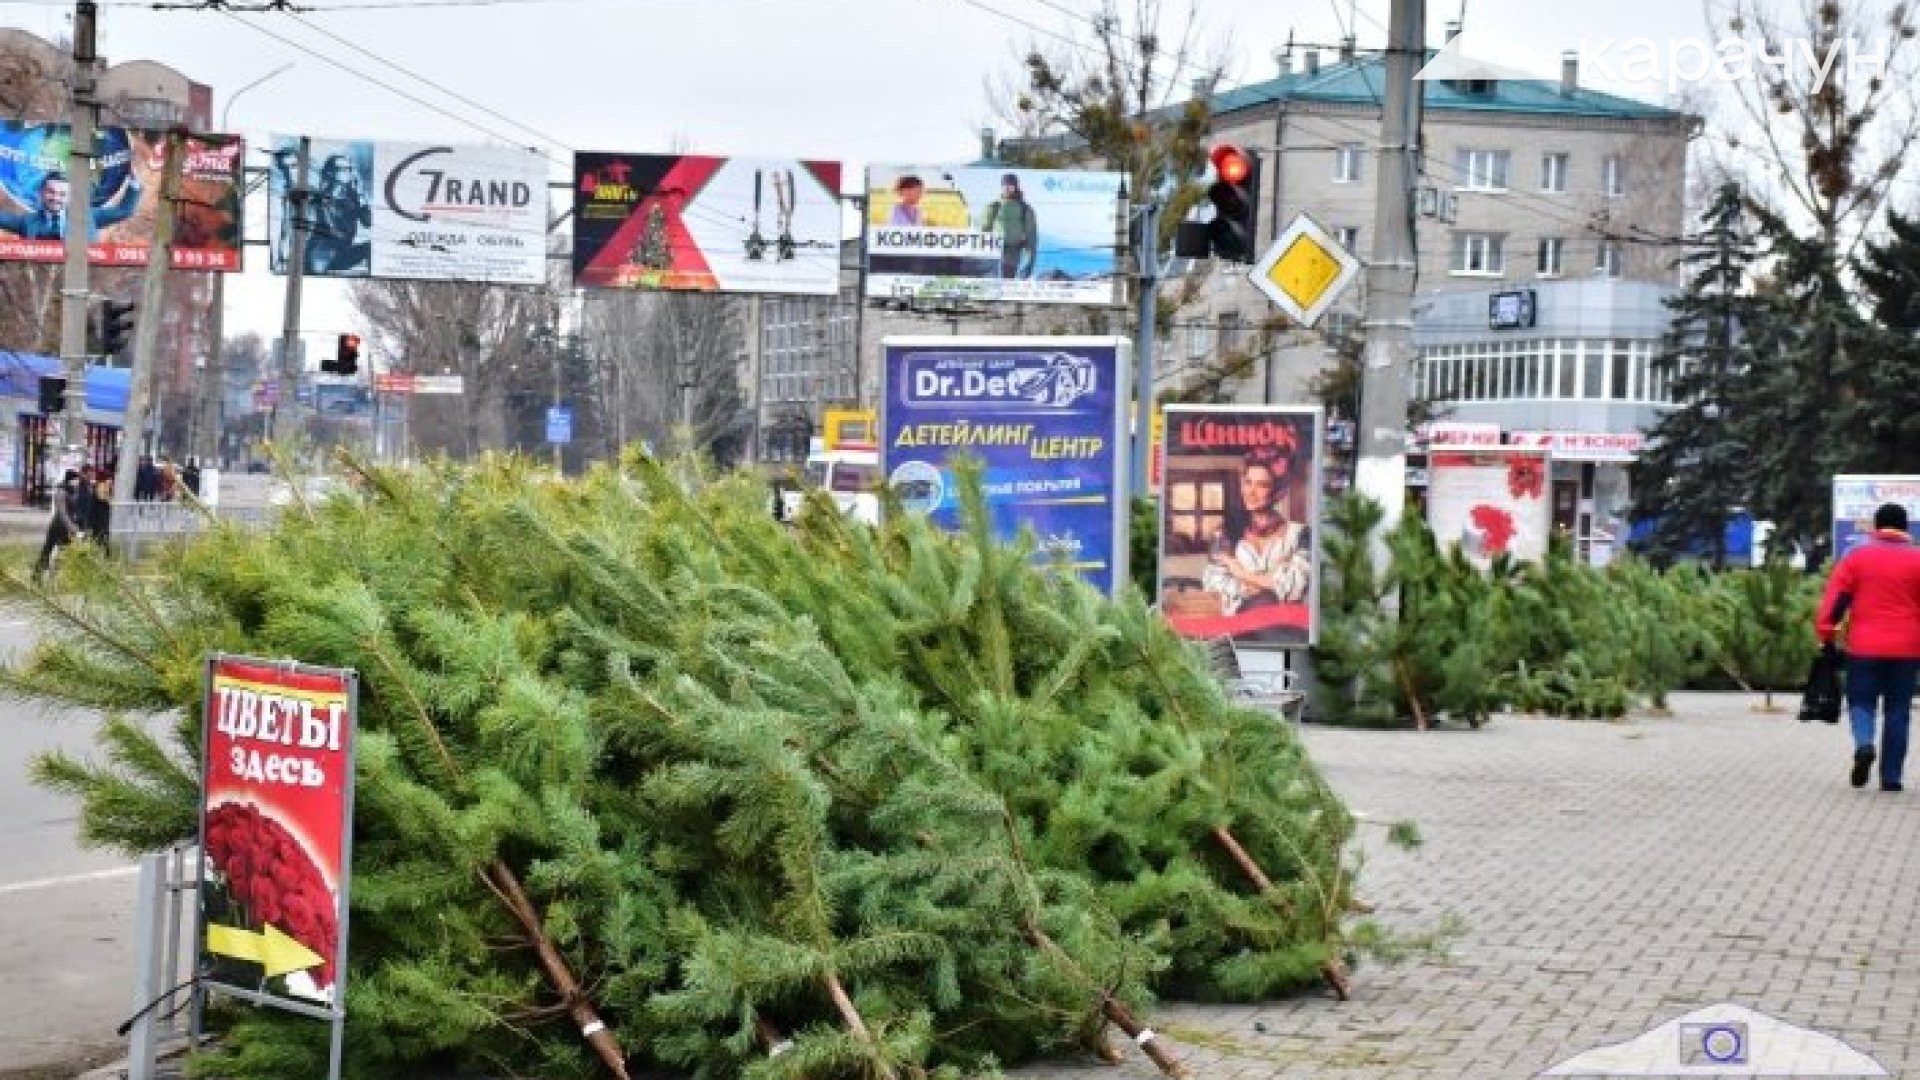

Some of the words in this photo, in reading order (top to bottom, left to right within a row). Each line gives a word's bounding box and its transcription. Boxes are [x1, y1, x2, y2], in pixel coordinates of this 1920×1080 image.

[894, 419, 1035, 448] ДЕТЕЙЛИНГ
[1030, 436, 1103, 460] ЦЕНТР
[217, 686, 342, 751] ЦВЕТЫ
[229, 745, 325, 787] здесь
